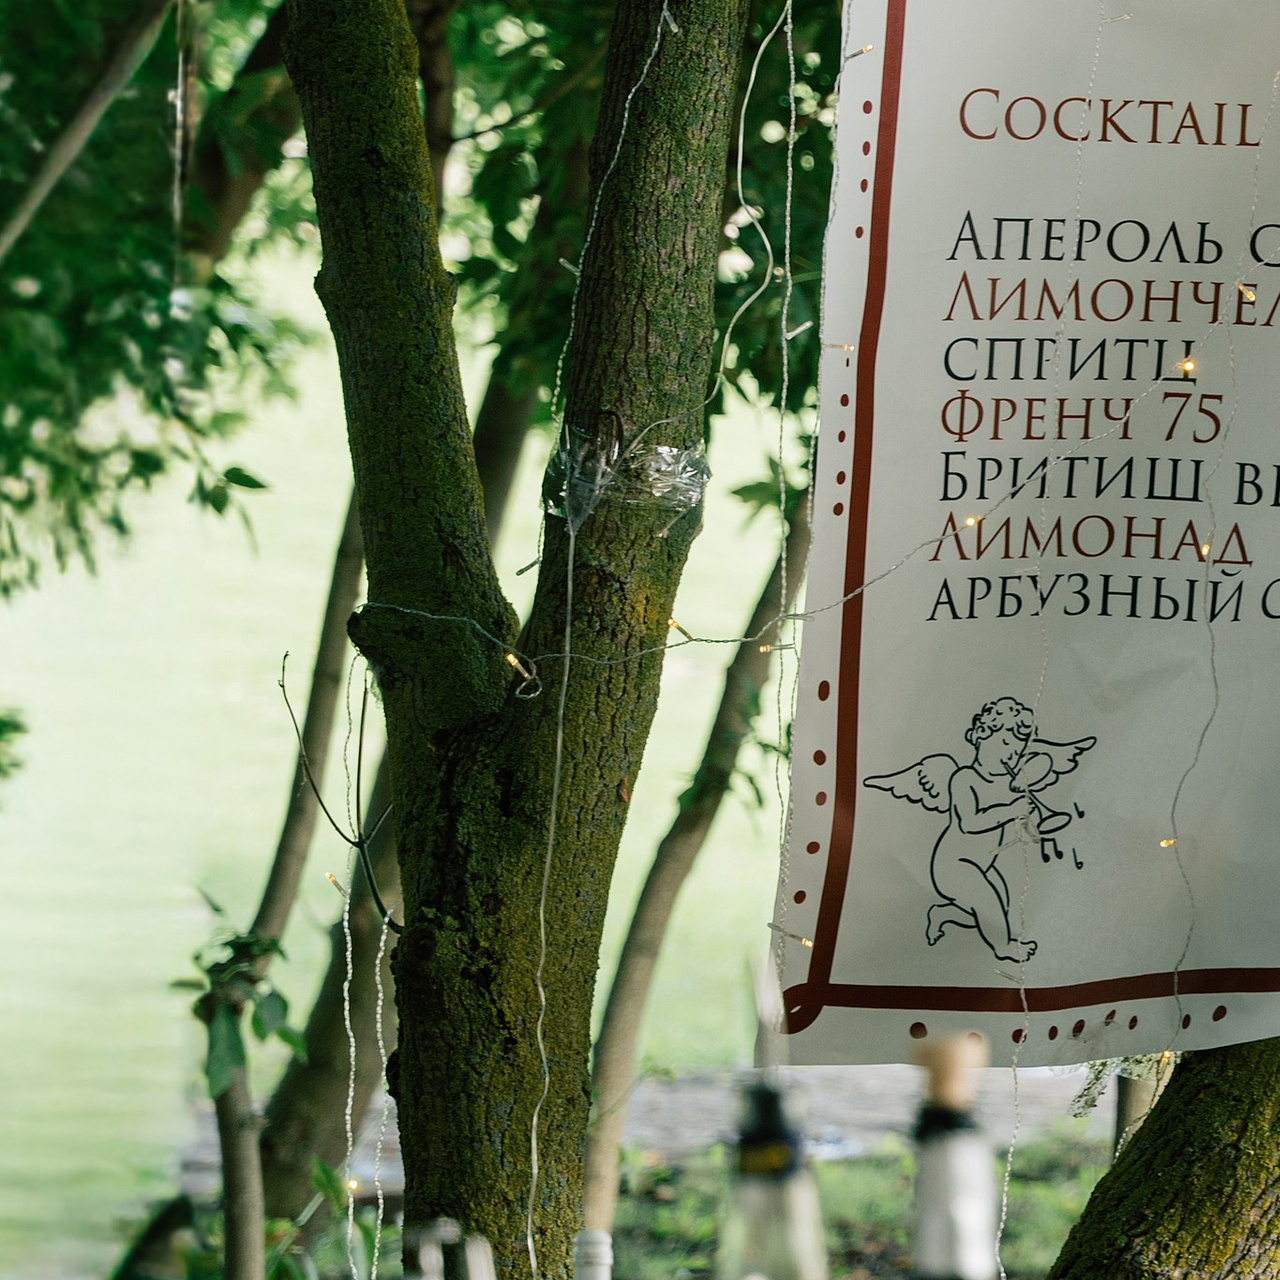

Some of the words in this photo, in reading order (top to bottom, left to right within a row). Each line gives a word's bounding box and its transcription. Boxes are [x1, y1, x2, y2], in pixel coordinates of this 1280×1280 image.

[959, 88, 1262, 147] COCKTAIL
[946, 210, 1224, 265] АПЕРОЛЬ
[940, 389, 1134, 444] ФРЕНЧ
[1161, 391, 1224, 444] 75
[939, 450, 1204, 503] БРИТИШ
[929, 512, 1253, 567] ЛИМОНАД
[926, 568, 1242, 624] АРБУЗНЫЙ
